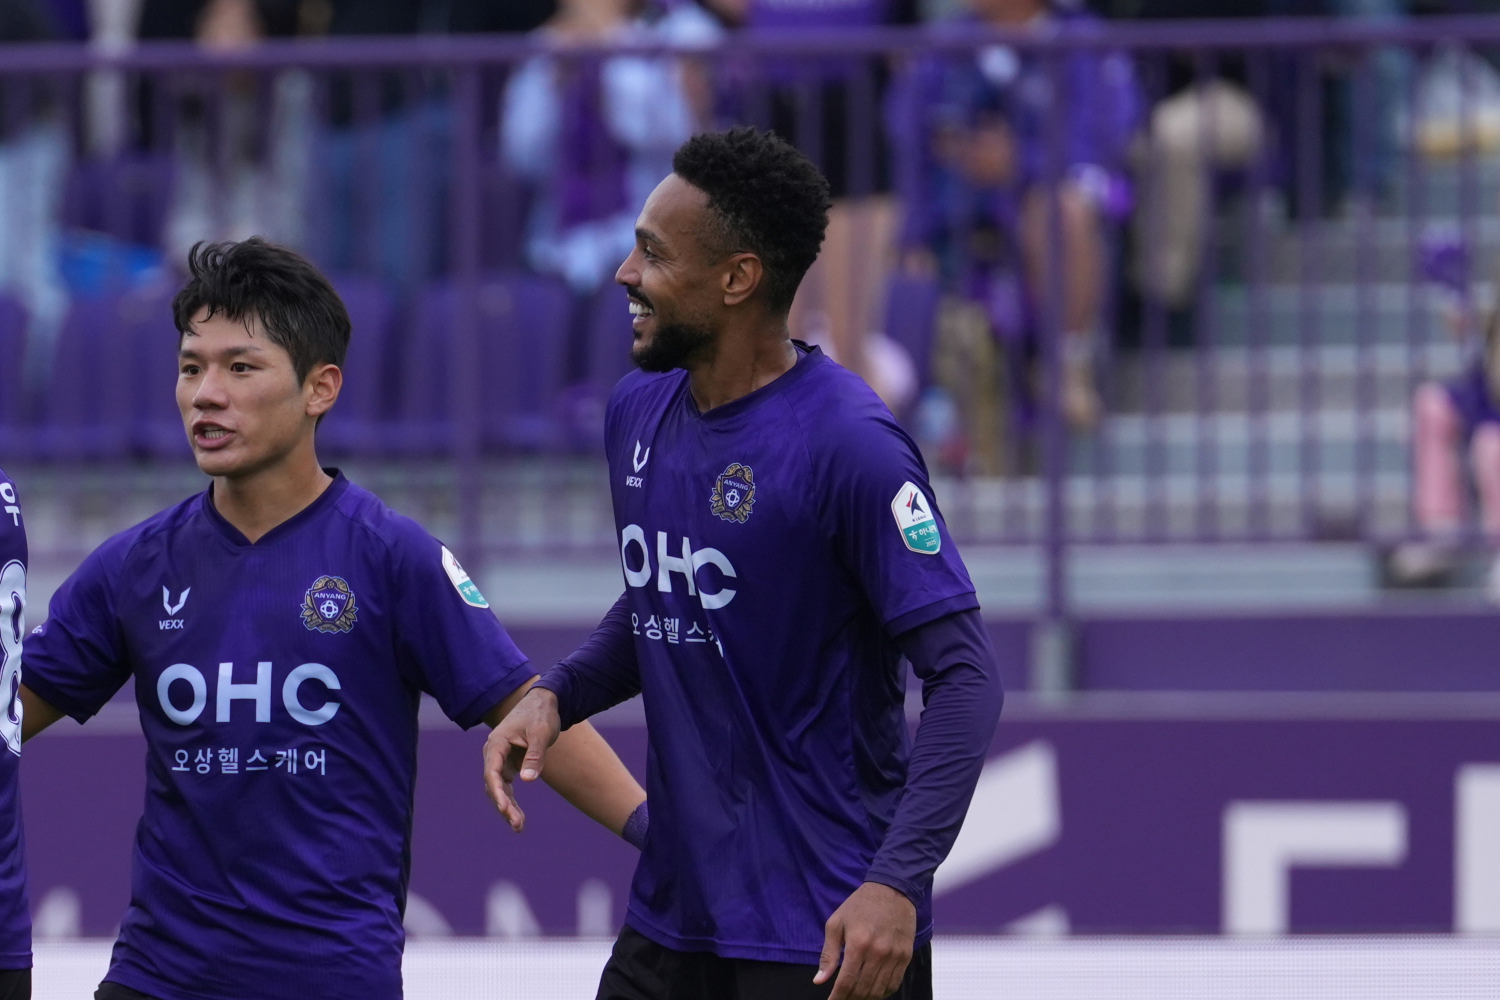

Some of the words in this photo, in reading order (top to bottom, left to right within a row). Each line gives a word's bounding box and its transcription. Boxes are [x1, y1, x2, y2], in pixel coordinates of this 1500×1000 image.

[626, 475, 643, 488] VEXX
[724, 479, 749, 491] ANYANG
[621, 523, 738, 610] OHC
[314, 592, 346, 600] ANYANG
[158, 619, 185, 631] VEXX
[156, 661, 342, 726] OHC
[171, 747, 326, 776] 오상헬스케어
